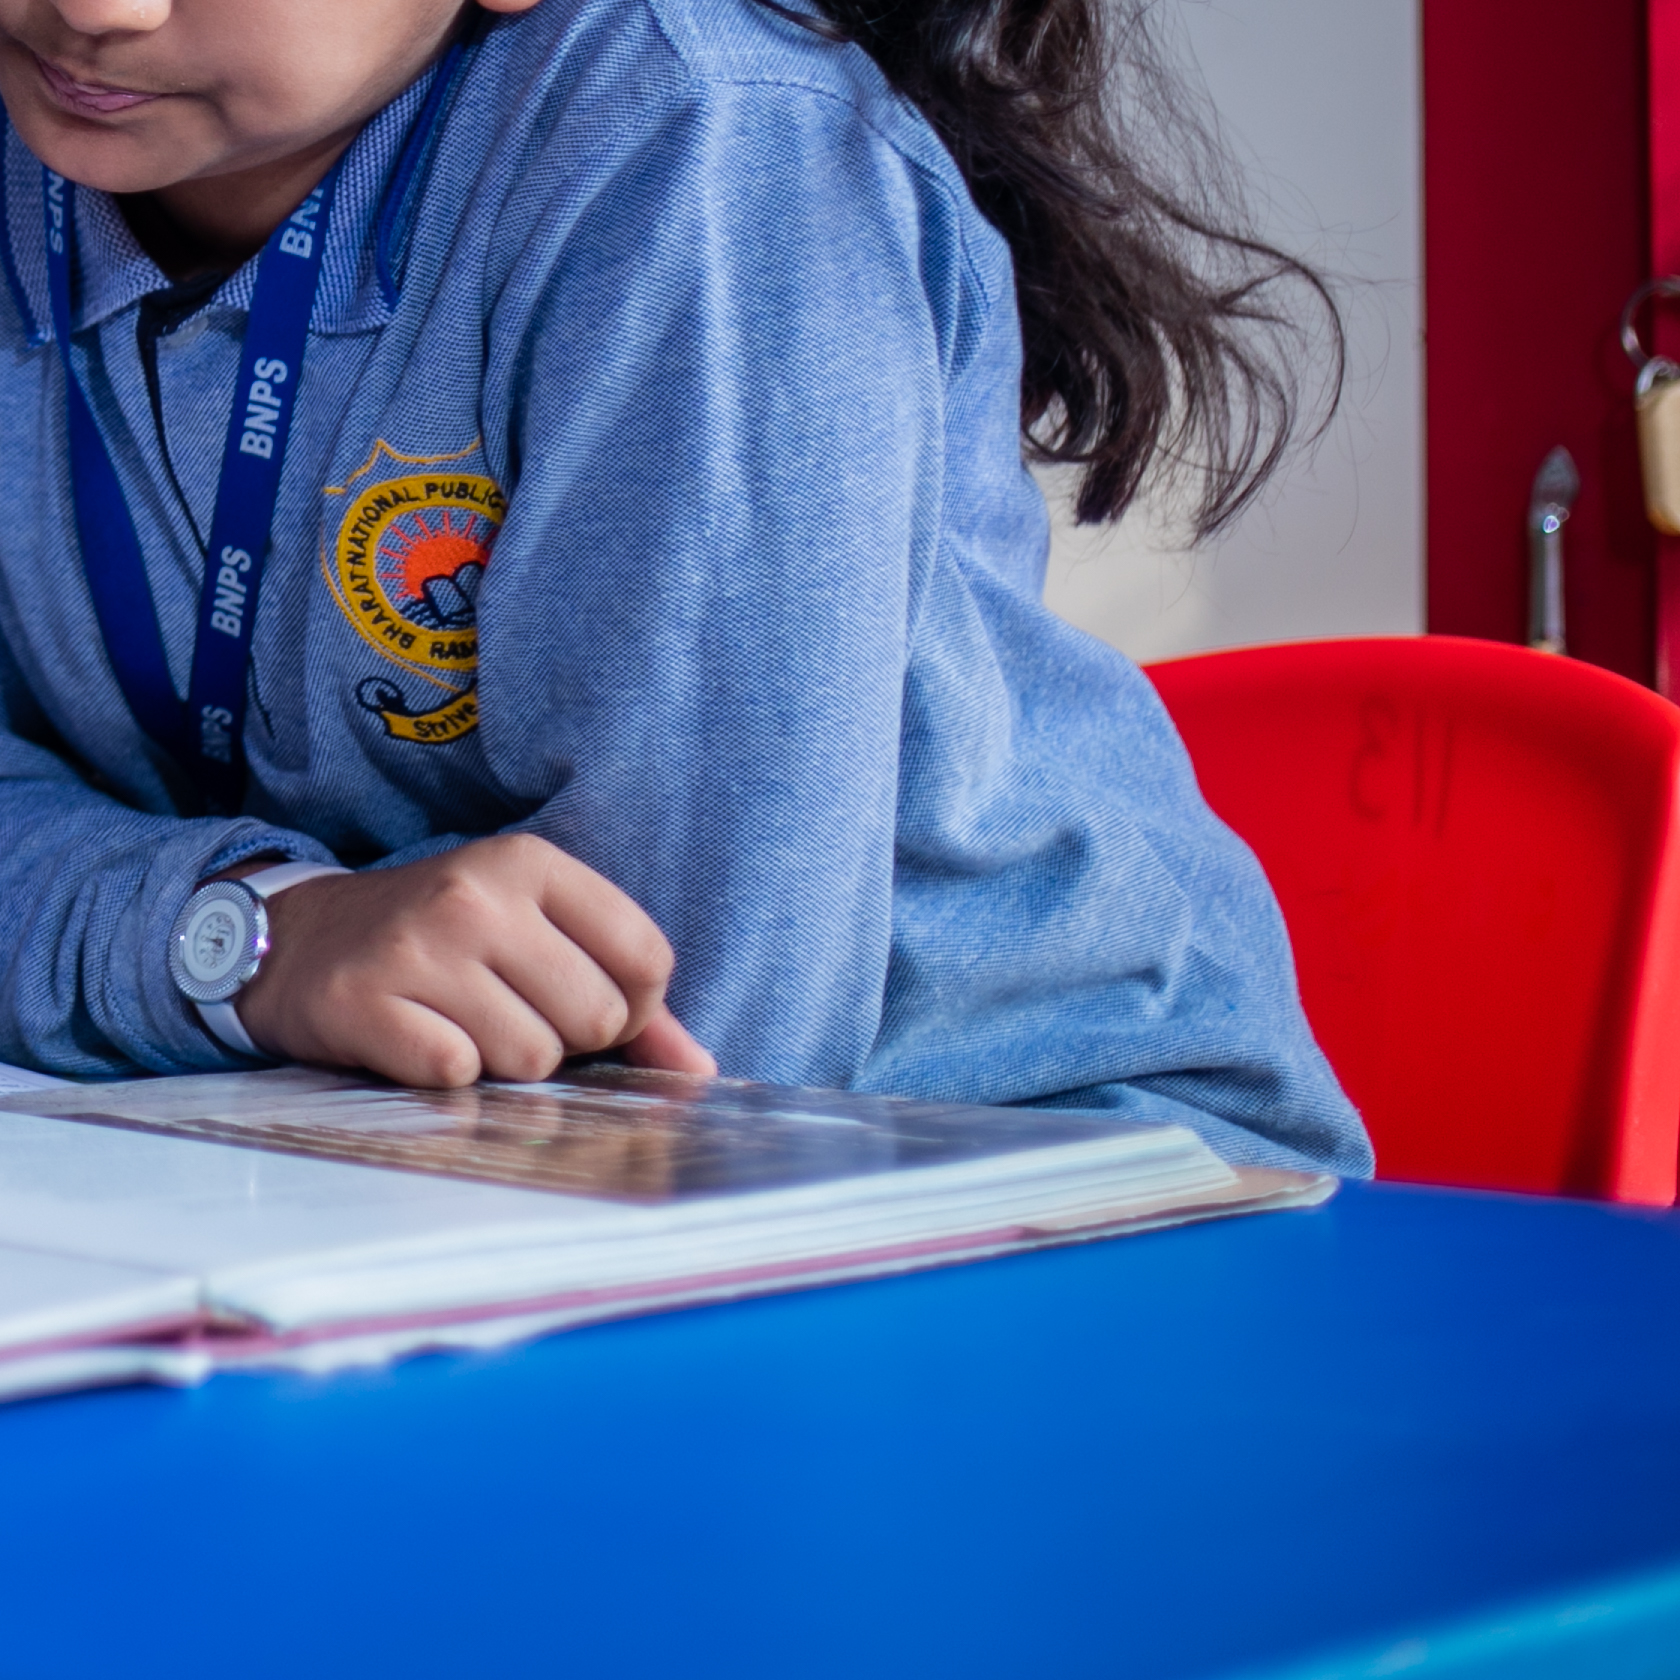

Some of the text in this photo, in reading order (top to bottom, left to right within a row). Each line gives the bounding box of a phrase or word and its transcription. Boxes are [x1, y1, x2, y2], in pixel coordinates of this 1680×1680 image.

[48, 171, 64, 255] NPS
[240, 356, 288, 460] BNPS
[346, 487, 419, 567] NATIONAL
[210, 544, 252, 638] BNPS
[350, 570, 417, 650] BHARAT
